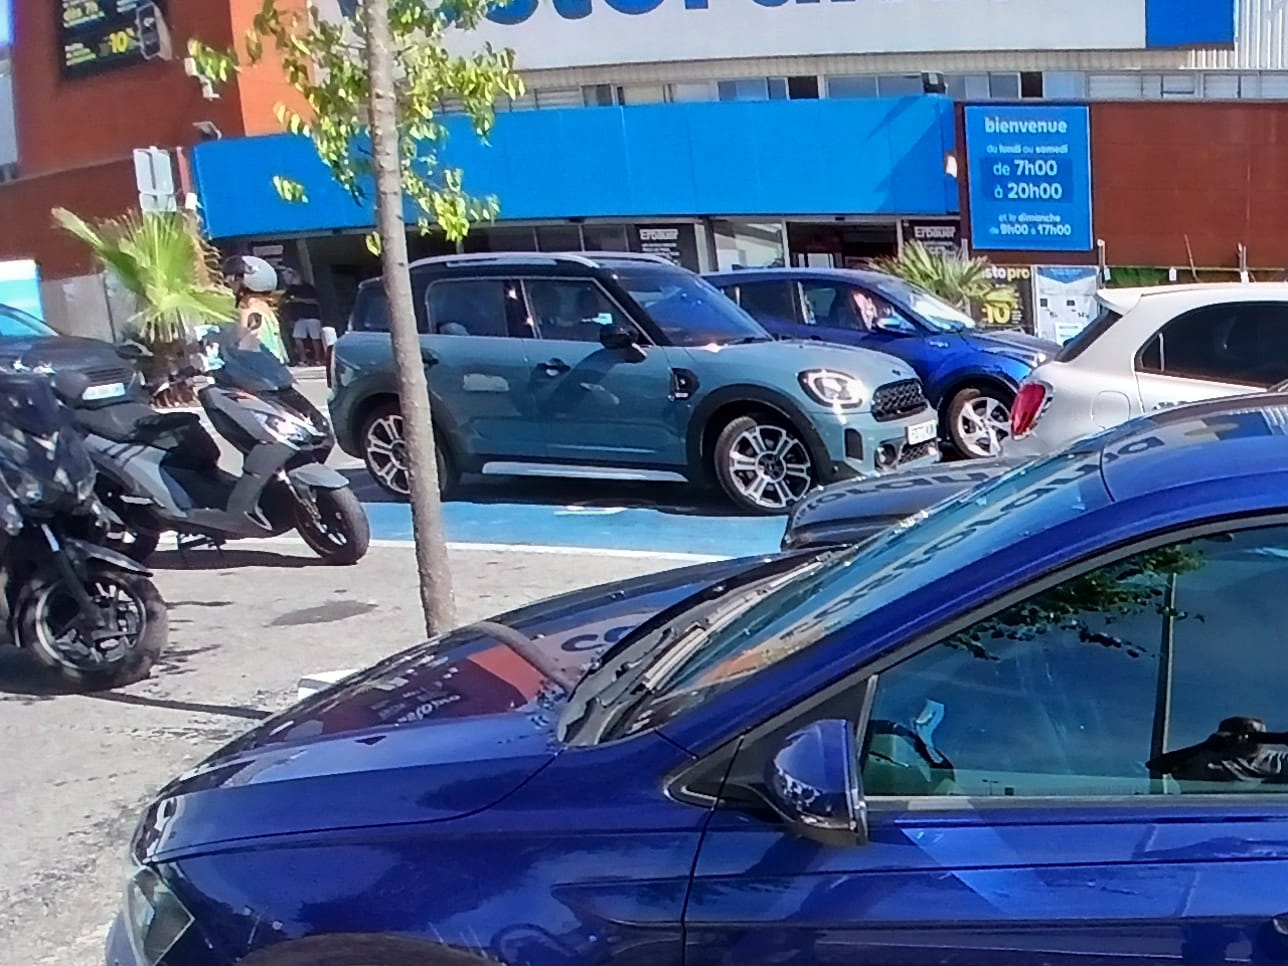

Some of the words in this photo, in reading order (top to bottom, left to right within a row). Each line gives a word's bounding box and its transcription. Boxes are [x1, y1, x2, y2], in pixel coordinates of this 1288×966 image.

[984, 116, 1068, 133] bienvenue
[993, 162, 1010, 176] de
[1014, 160, 1057, 176] 7h00
[994, 184, 1003, 199] à
[1007, 182, 1063, 200] 20h00
[1037, 223, 1071, 236] 17h00
